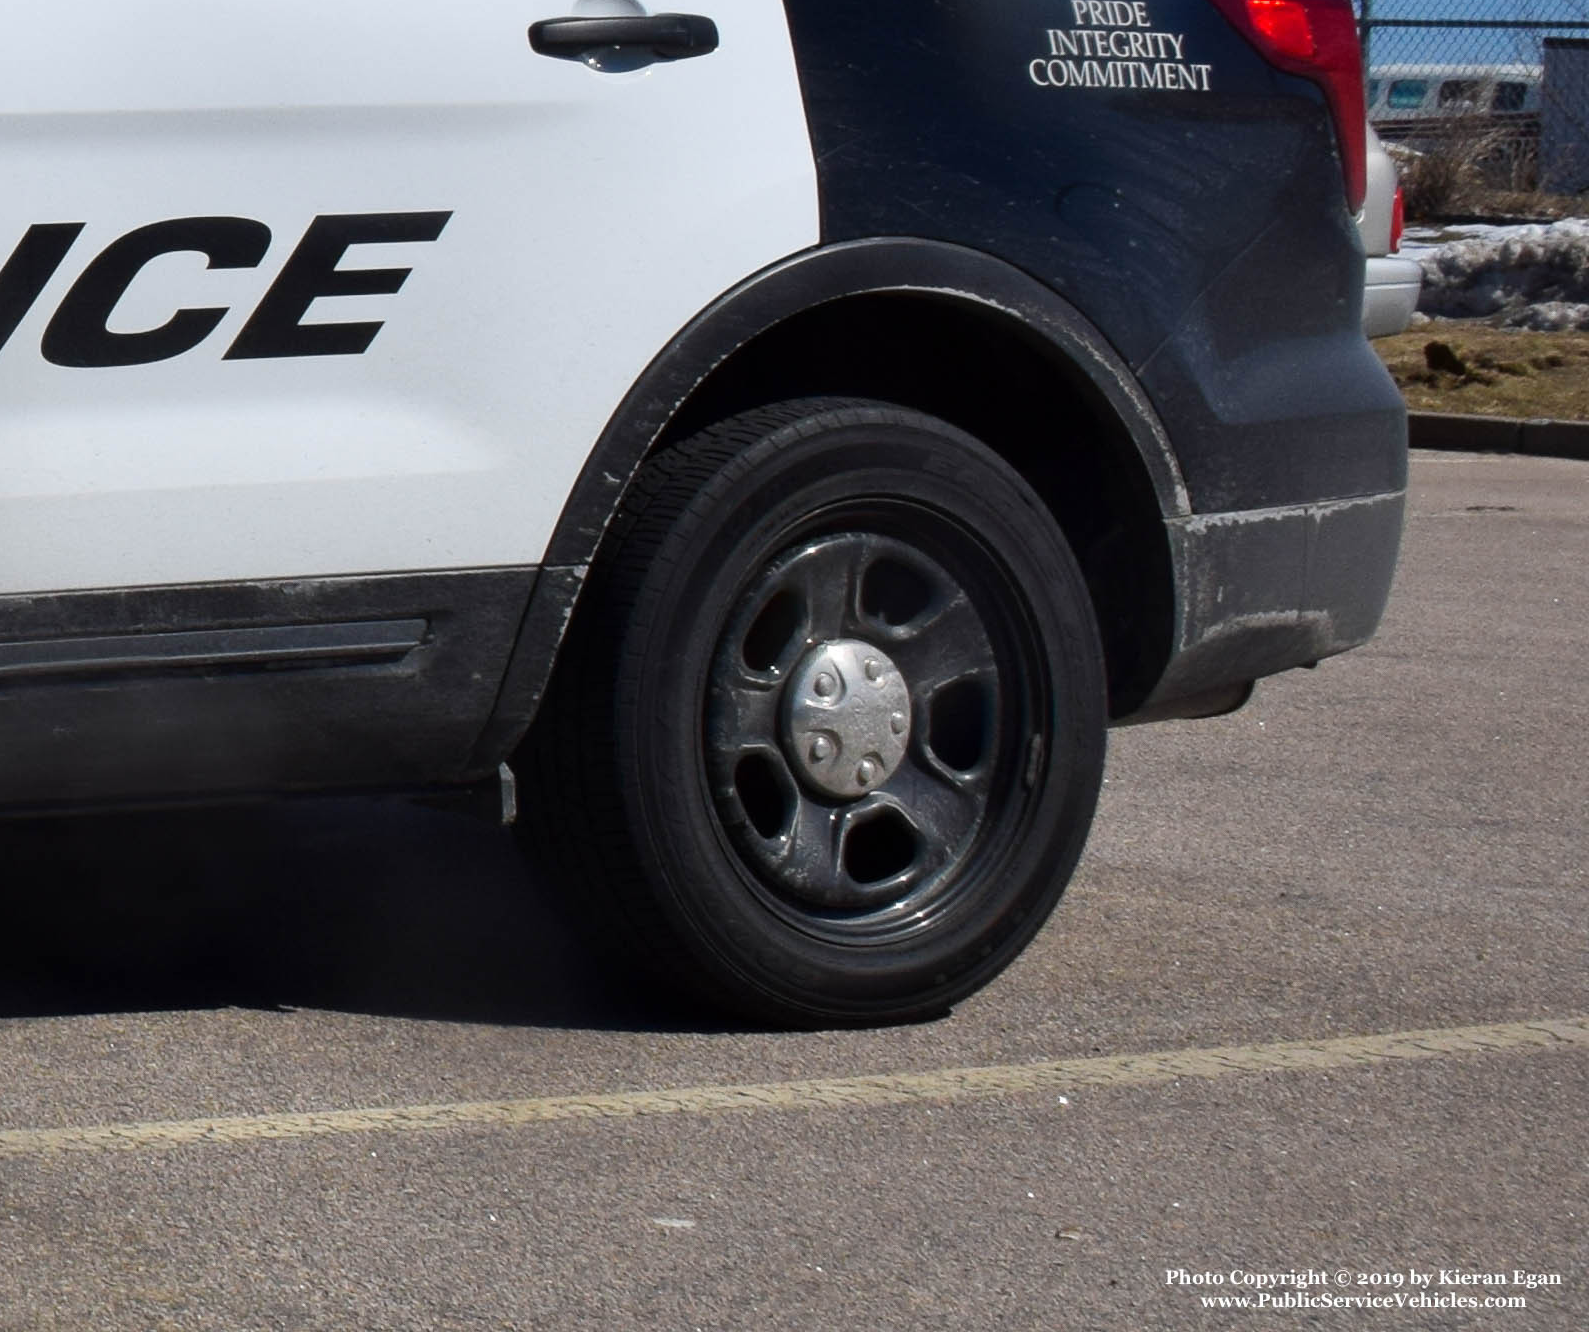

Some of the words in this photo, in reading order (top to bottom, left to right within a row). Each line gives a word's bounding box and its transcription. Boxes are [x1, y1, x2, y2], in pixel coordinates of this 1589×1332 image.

[1070, 0, 1151, 27] PRIDE
[1047, 29, 1183, 59] INTEGRITY
[1028, 58, 1211, 91] COMMITMENT
